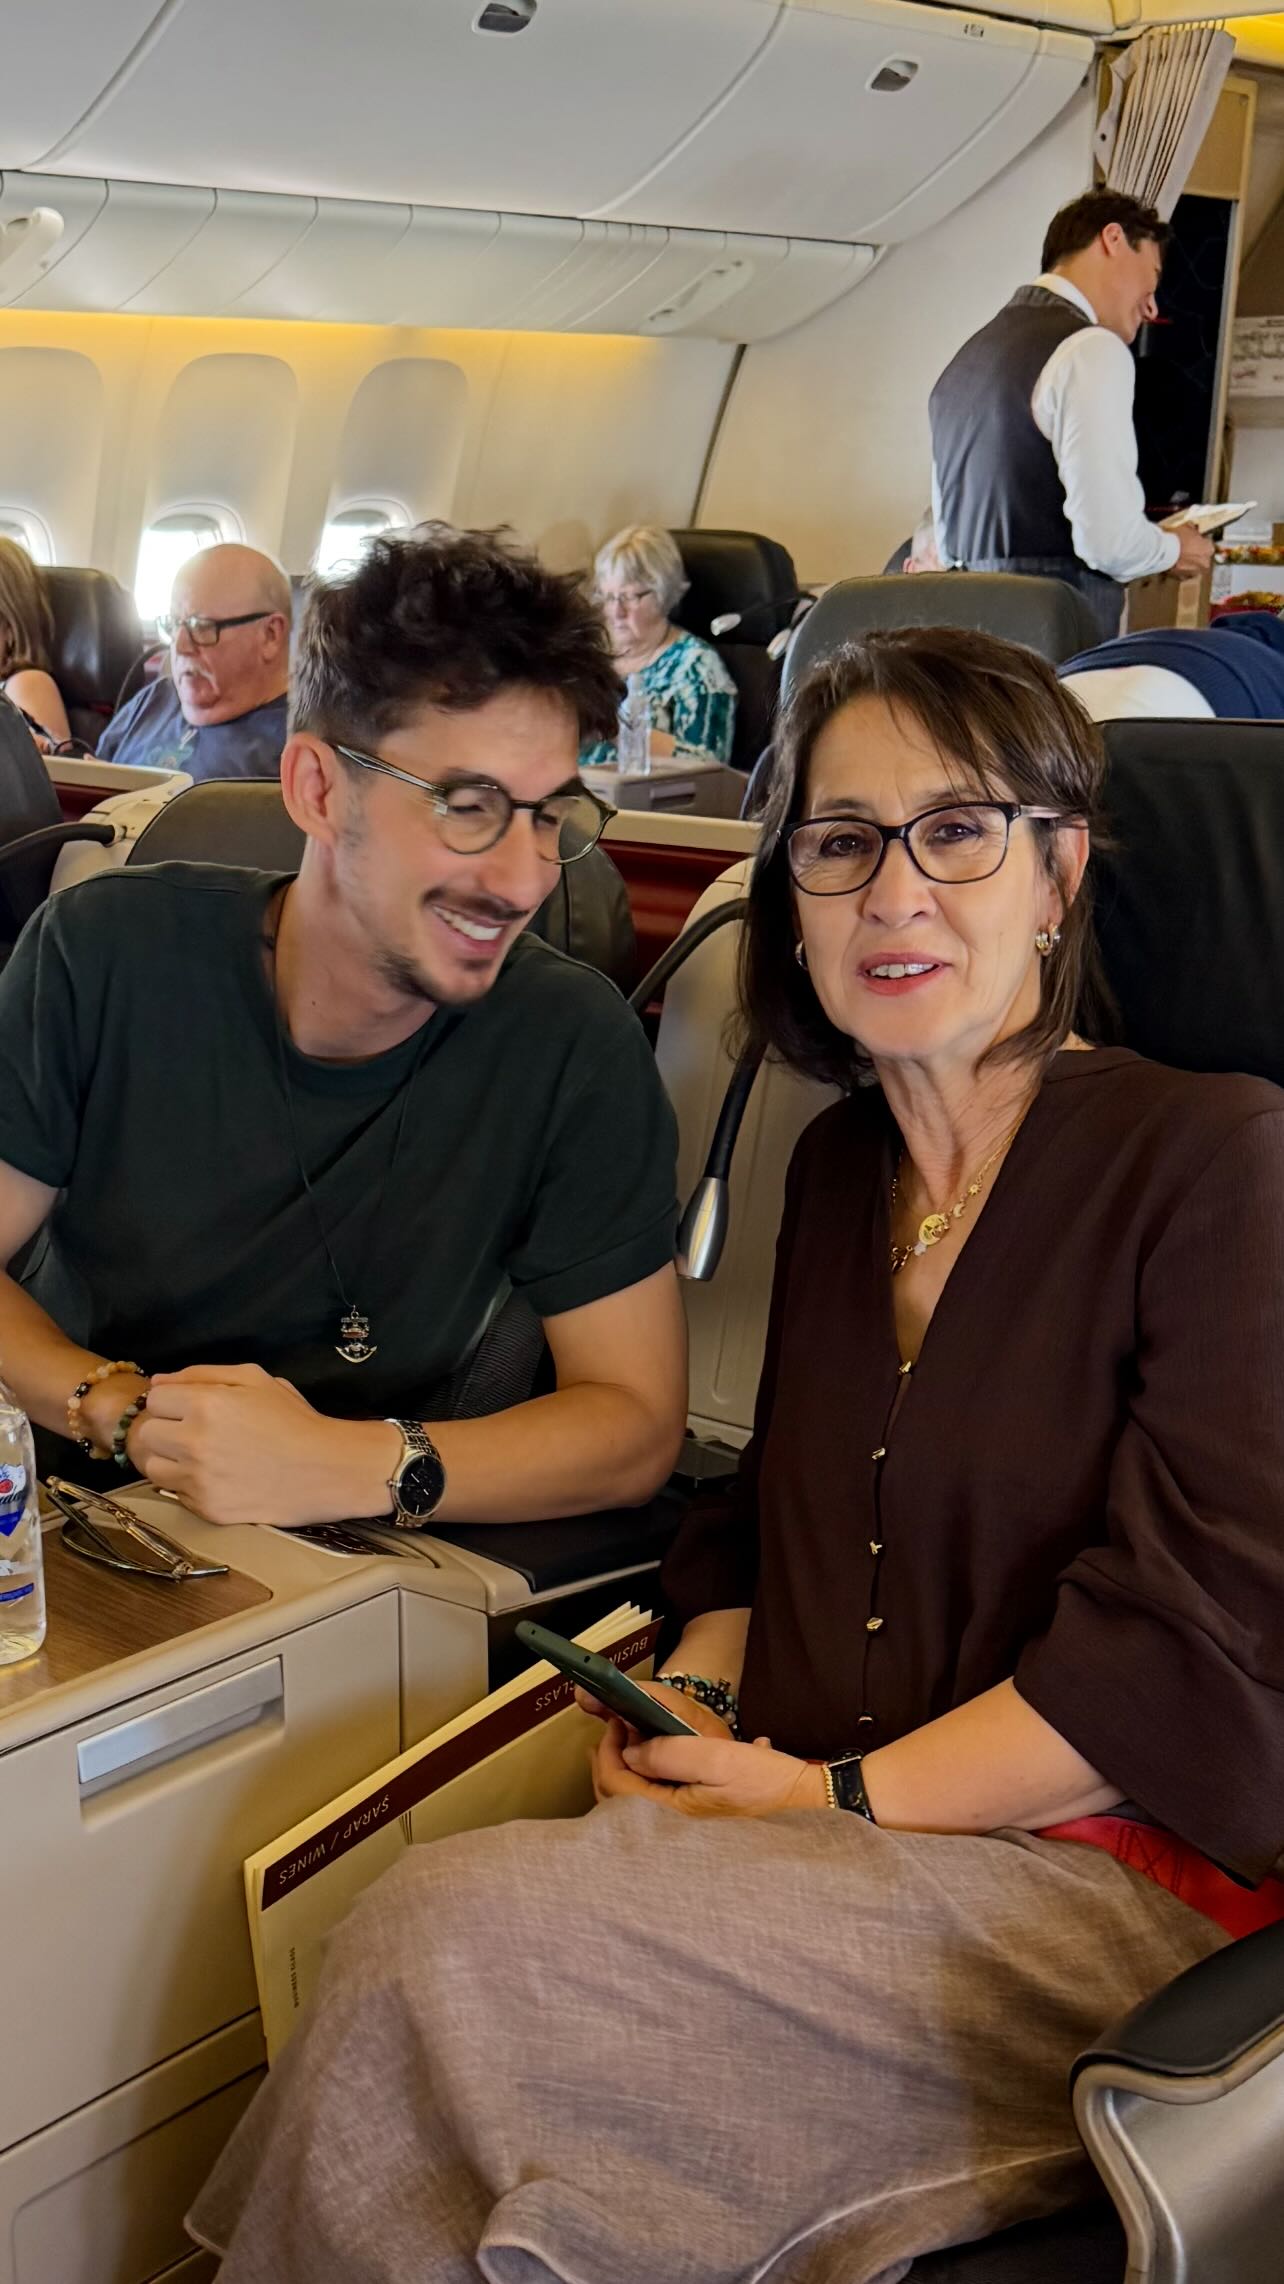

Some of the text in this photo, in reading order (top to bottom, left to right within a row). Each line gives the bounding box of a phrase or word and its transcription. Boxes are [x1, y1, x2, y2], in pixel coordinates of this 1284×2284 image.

[609, 1636, 649, 1664] BUSIN
[330, 1832, 340, 1851] /
[279, 1843, 326, 1885] WINES
